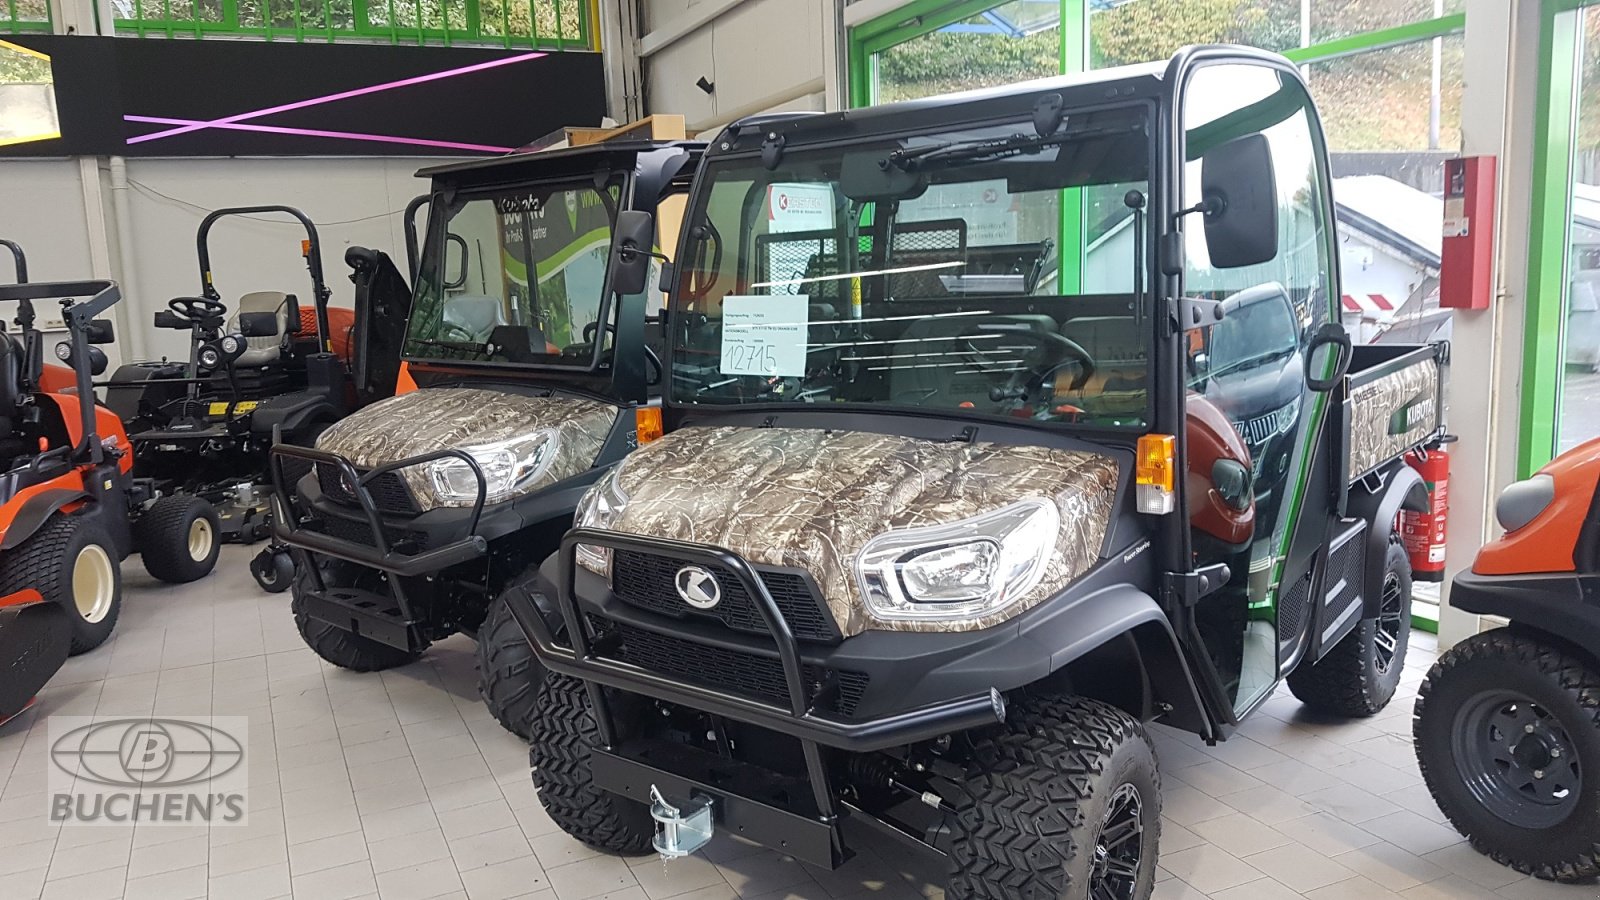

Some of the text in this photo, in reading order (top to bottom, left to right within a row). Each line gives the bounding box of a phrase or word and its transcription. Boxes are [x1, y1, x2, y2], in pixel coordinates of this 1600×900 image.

[725, 345, 776, 372] 12715
[1354, 385, 1383, 404] DIESEL
[1407, 398, 1434, 426] KUBOTA
